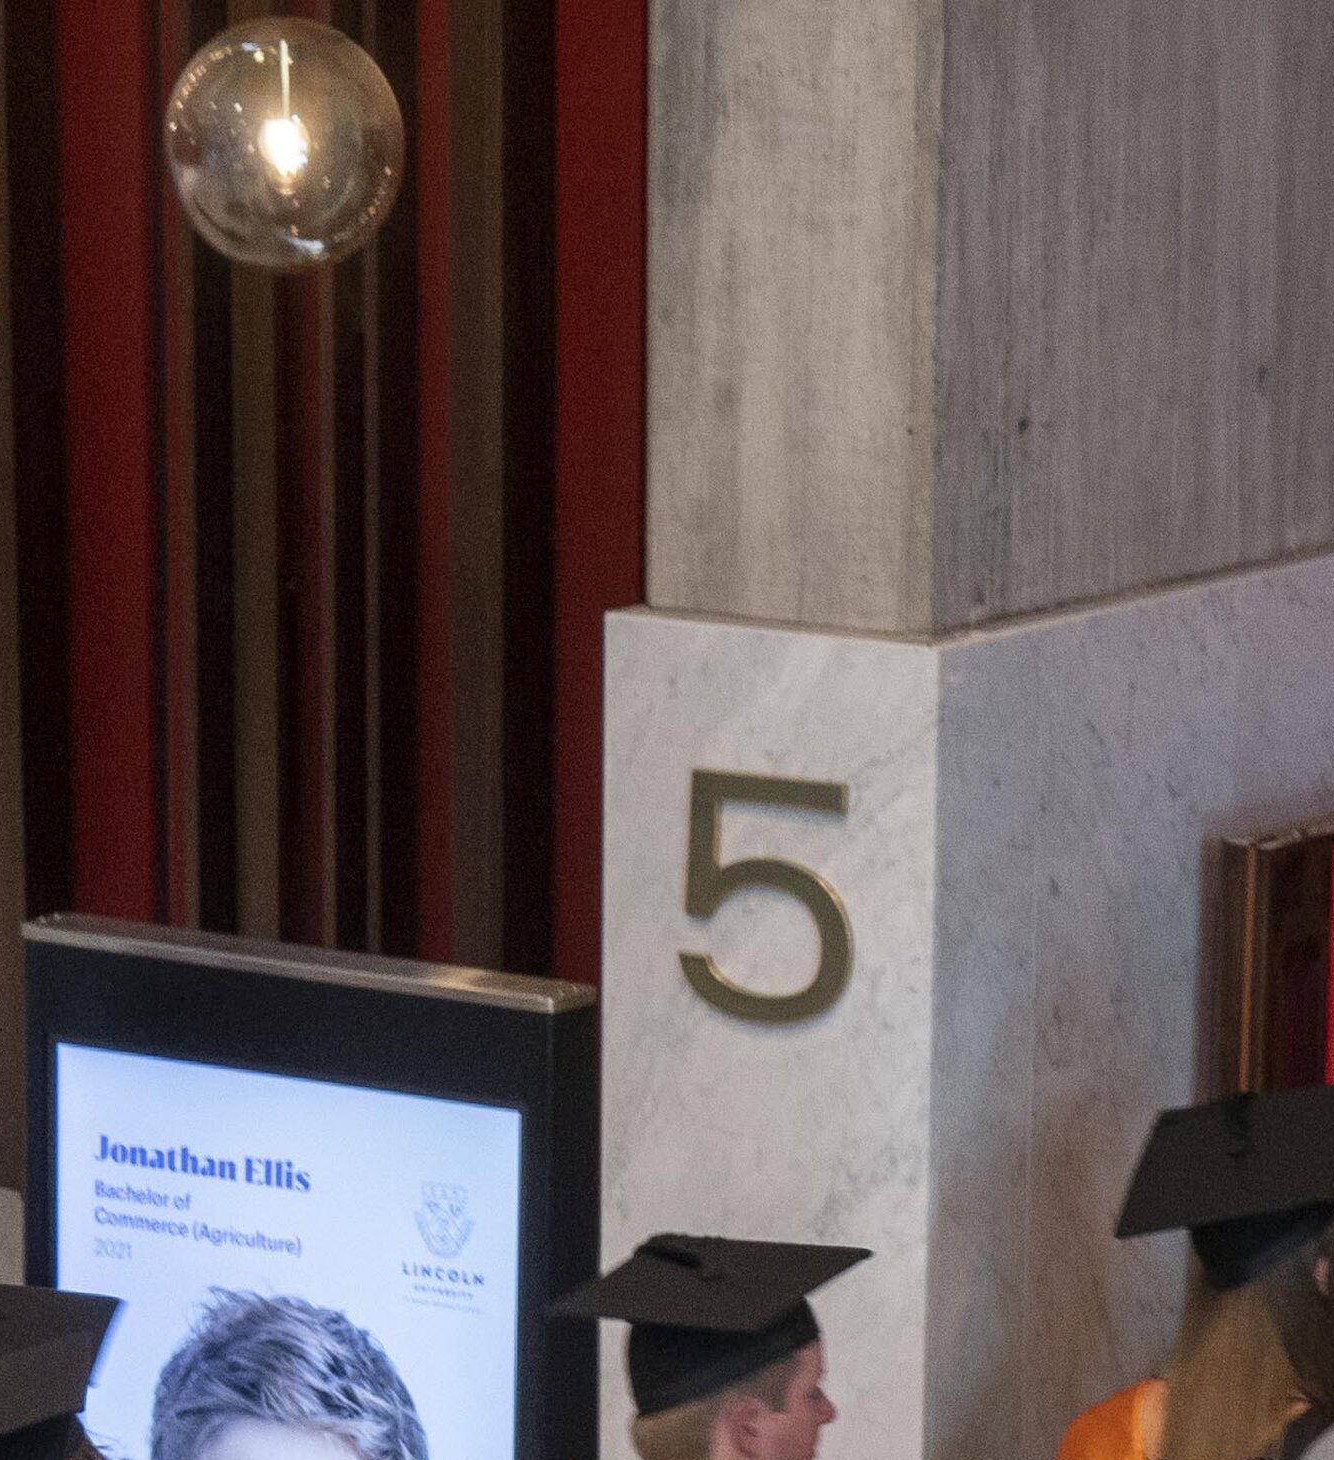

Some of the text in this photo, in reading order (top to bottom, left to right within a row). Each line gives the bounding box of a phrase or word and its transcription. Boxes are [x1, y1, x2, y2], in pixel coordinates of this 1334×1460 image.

[678, 768, 855, 1025] 5
[94, 1134, 311, 1193] Jonathan Ellis
[94, 1178, 192, 1211] Bachelor of
[94, 1205, 302, 1257] Commerce (Agriculture)
[94, 1236, 133, 1260] 2021
[401, 1260, 486, 1287] LINCOLN
